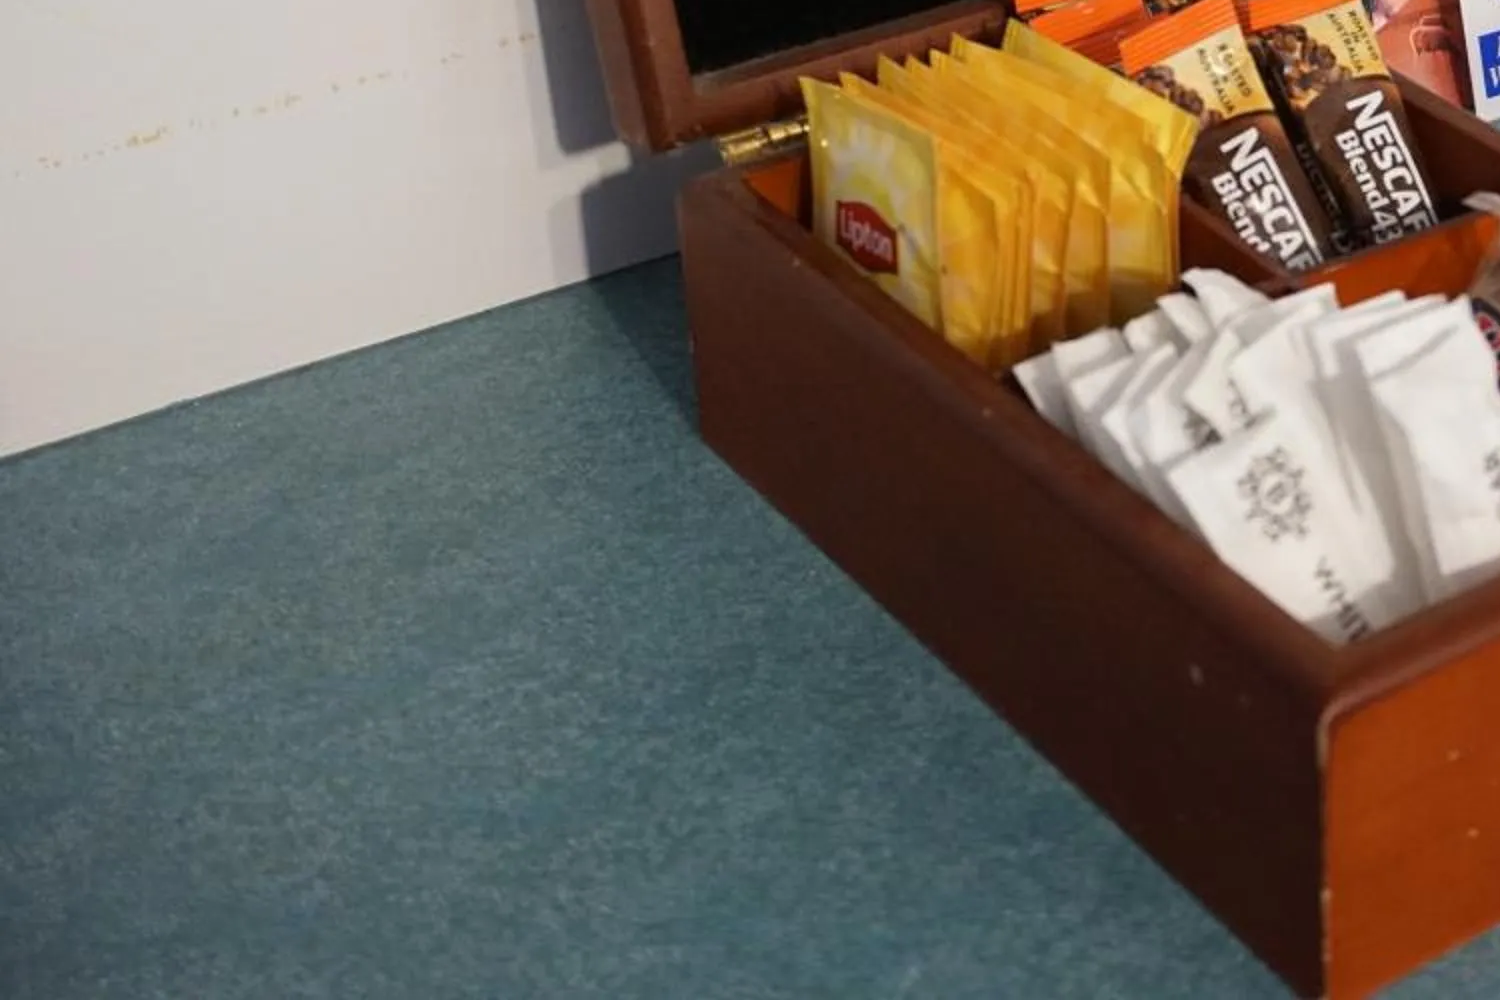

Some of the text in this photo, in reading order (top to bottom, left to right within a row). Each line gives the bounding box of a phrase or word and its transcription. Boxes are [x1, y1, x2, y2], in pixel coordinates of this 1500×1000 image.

[1220, 127, 1324, 270] NESCAF
[1345, 90, 1439, 233] NESCAF
[840, 208, 894, 263] Lipton
